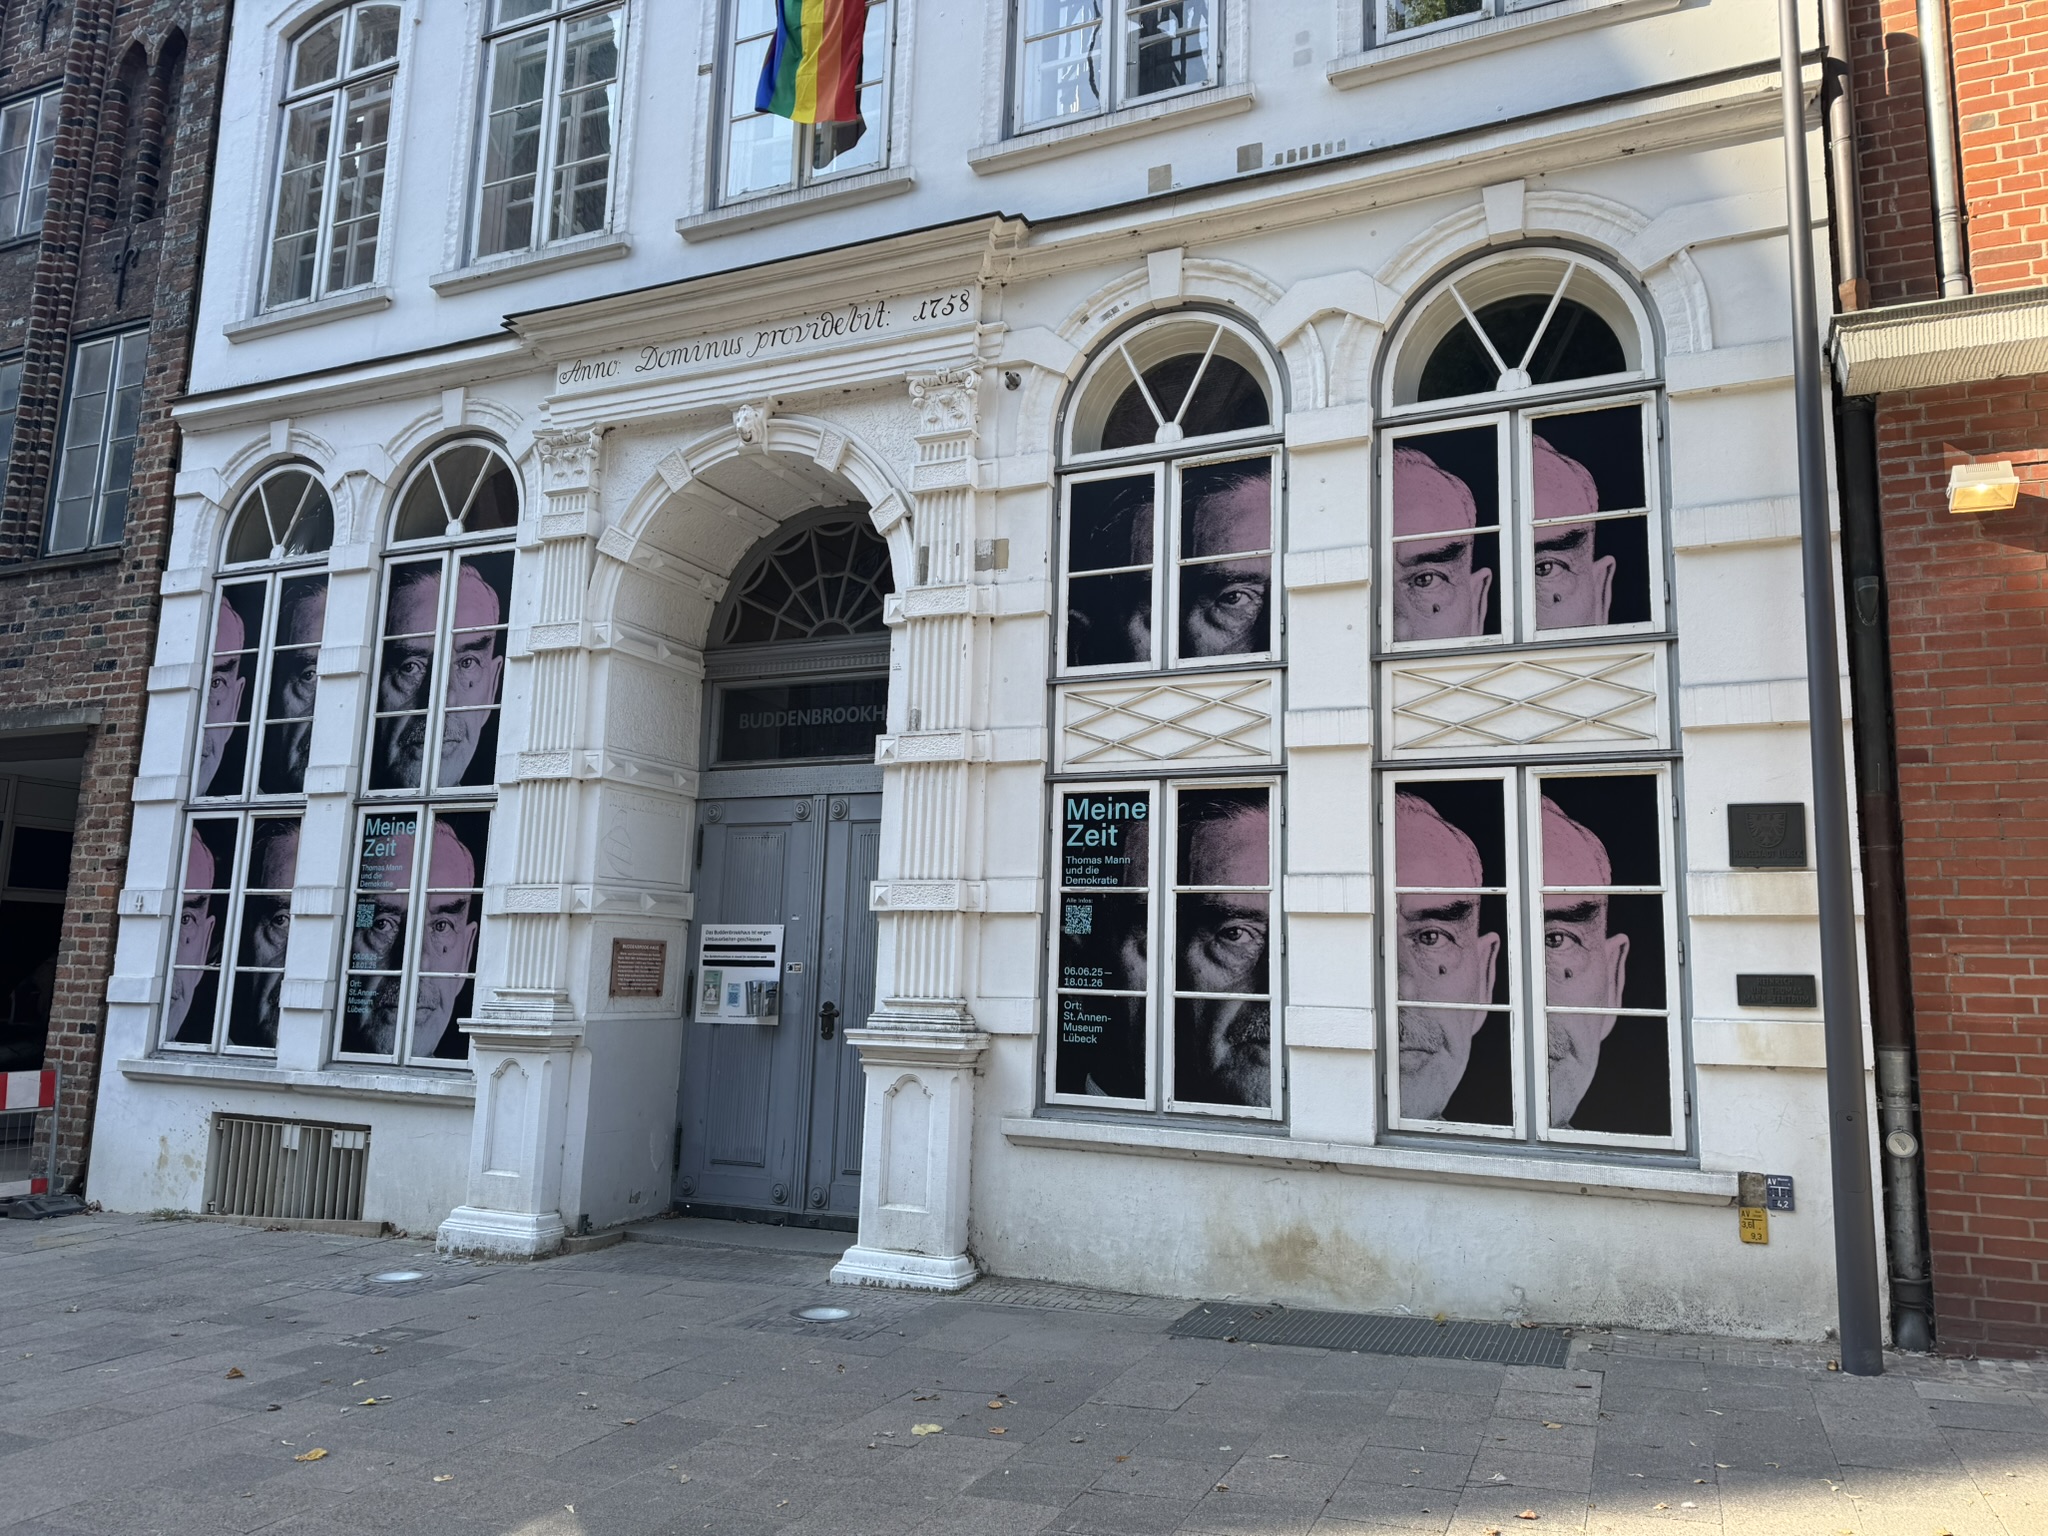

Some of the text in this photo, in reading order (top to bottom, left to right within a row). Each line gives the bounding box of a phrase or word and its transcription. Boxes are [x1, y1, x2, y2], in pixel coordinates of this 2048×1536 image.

[558, 358, 621, 386] Anno:
[634, 334, 745, 374] Dominus
[912, 290, 971, 322] 1758
[1067, 796, 1147, 821] Meine
[366, 817, 416, 836] Meine
[1066, 823, 1119, 847] Zeit
[363, 838, 397, 857] Zeit
[1065, 855, 1131, 865] Thomas Mann
[361, 864, 403, 872] Thomas Mann
[1065, 866, 1100, 875] und die
[360, 872, 383, 880] und die
[1065, 876, 1119, 885] Demokratie
[360, 880, 393, 888] Demokratie
[1063, 978, 1103, 987] 18.01.26
[348, 997, 373, 1005] Museum
[1063, 1000, 1082, 1010] Ort:
[347, 1005, 369, 1013] Lübeck
[1063, 1011, 1112, 1022] St. Annen-
[1063, 1022, 1103, 1033] Museum
[1063, 1033, 1098, 1044] Lübeck
